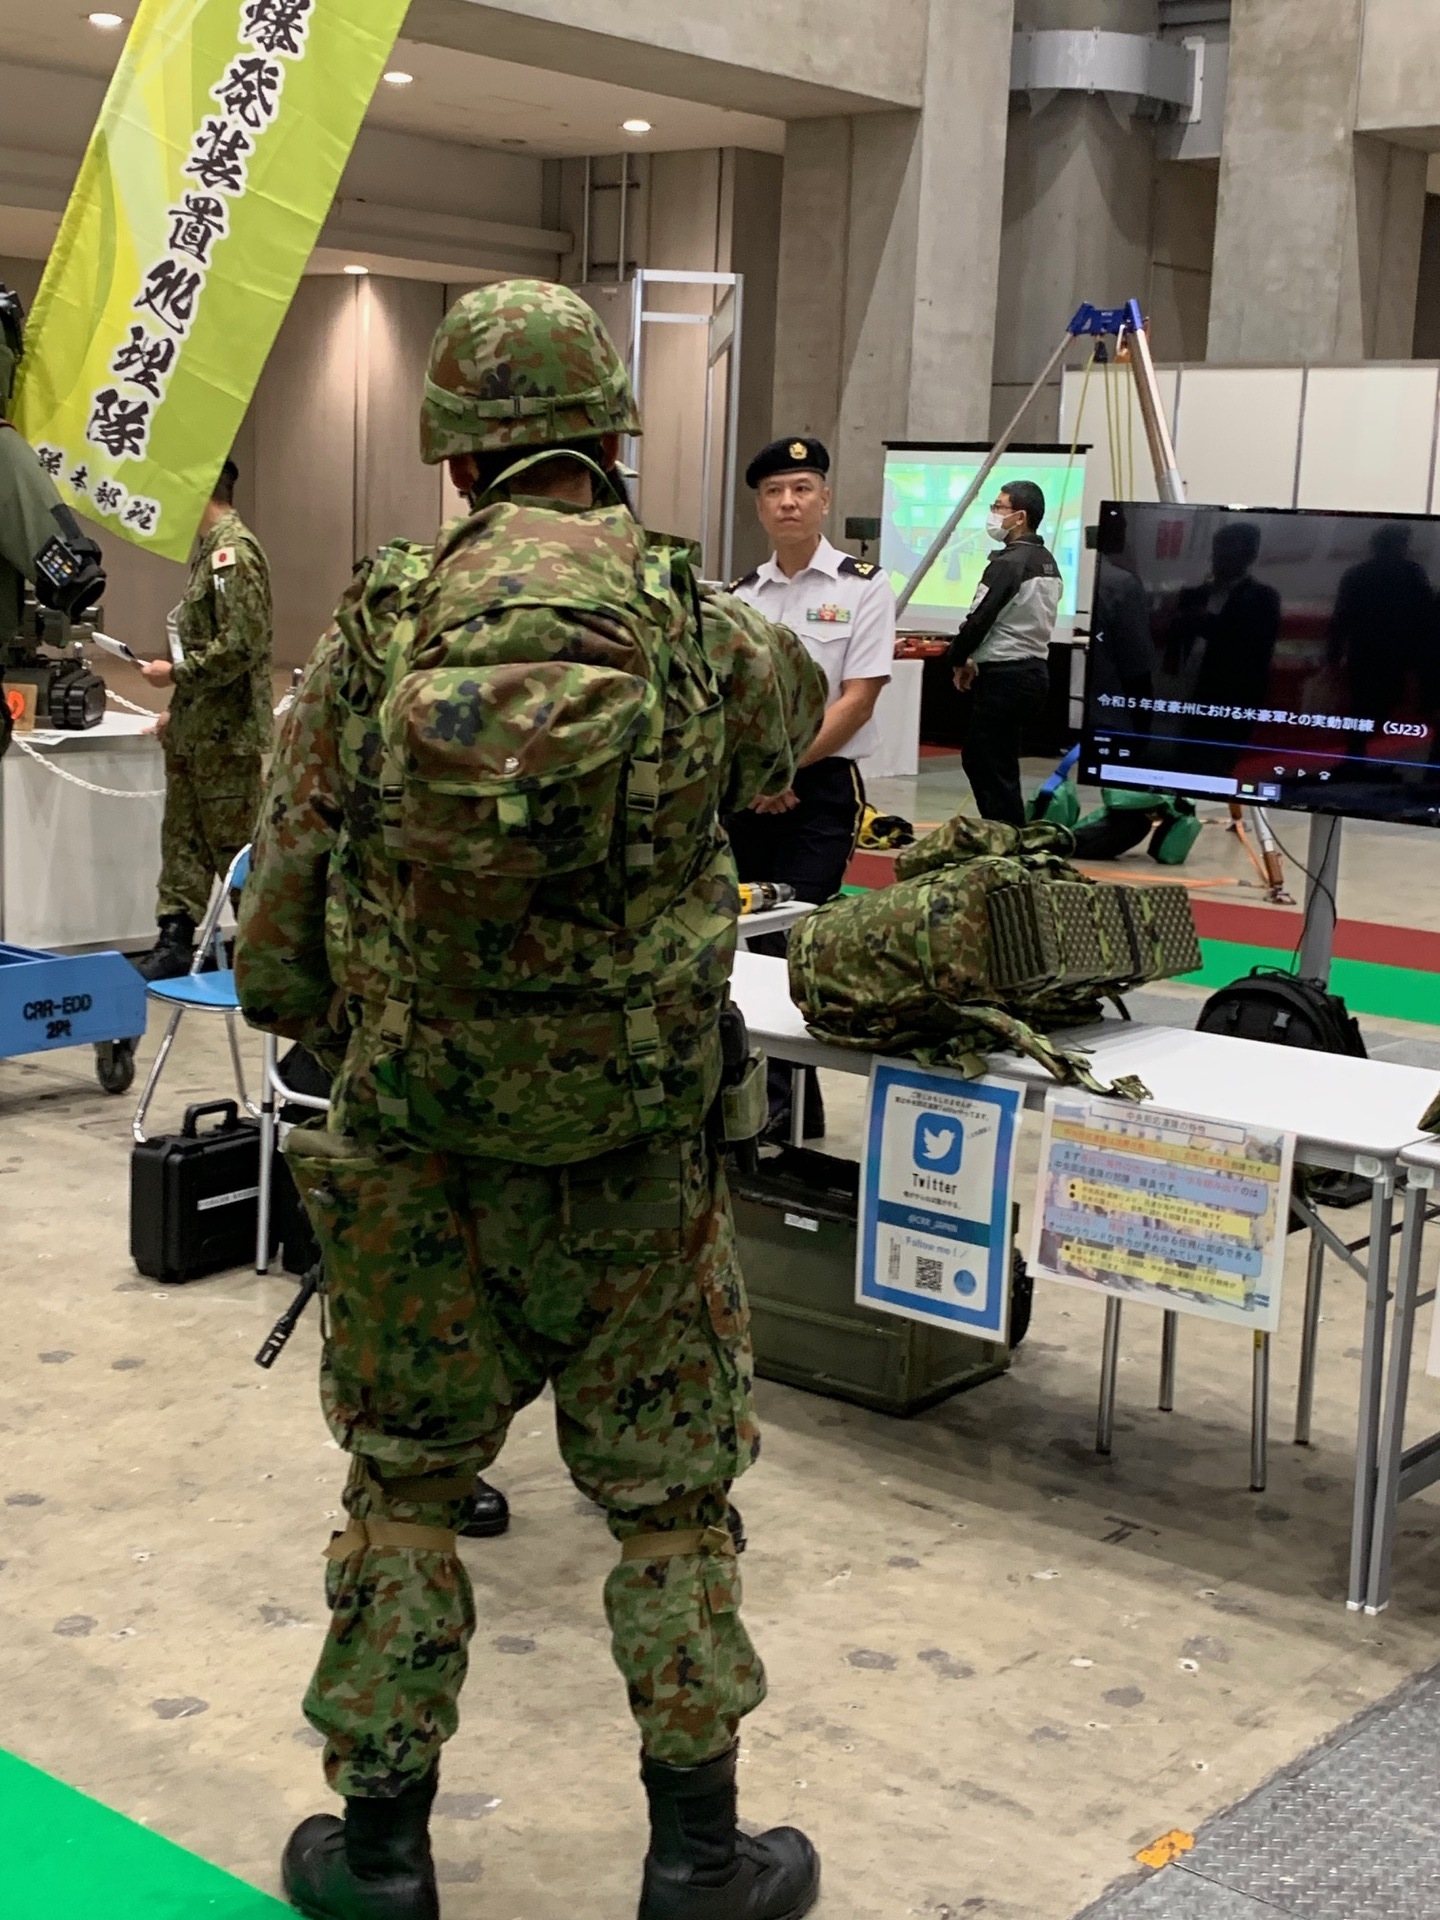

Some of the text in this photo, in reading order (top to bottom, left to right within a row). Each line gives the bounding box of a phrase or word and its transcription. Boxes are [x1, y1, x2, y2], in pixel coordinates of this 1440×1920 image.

[86, 0, 310, 456] 爆発装置処理隊
[912, 1173, 958, 1195] Twitter
[905, 1236, 934, 1252] Follow
